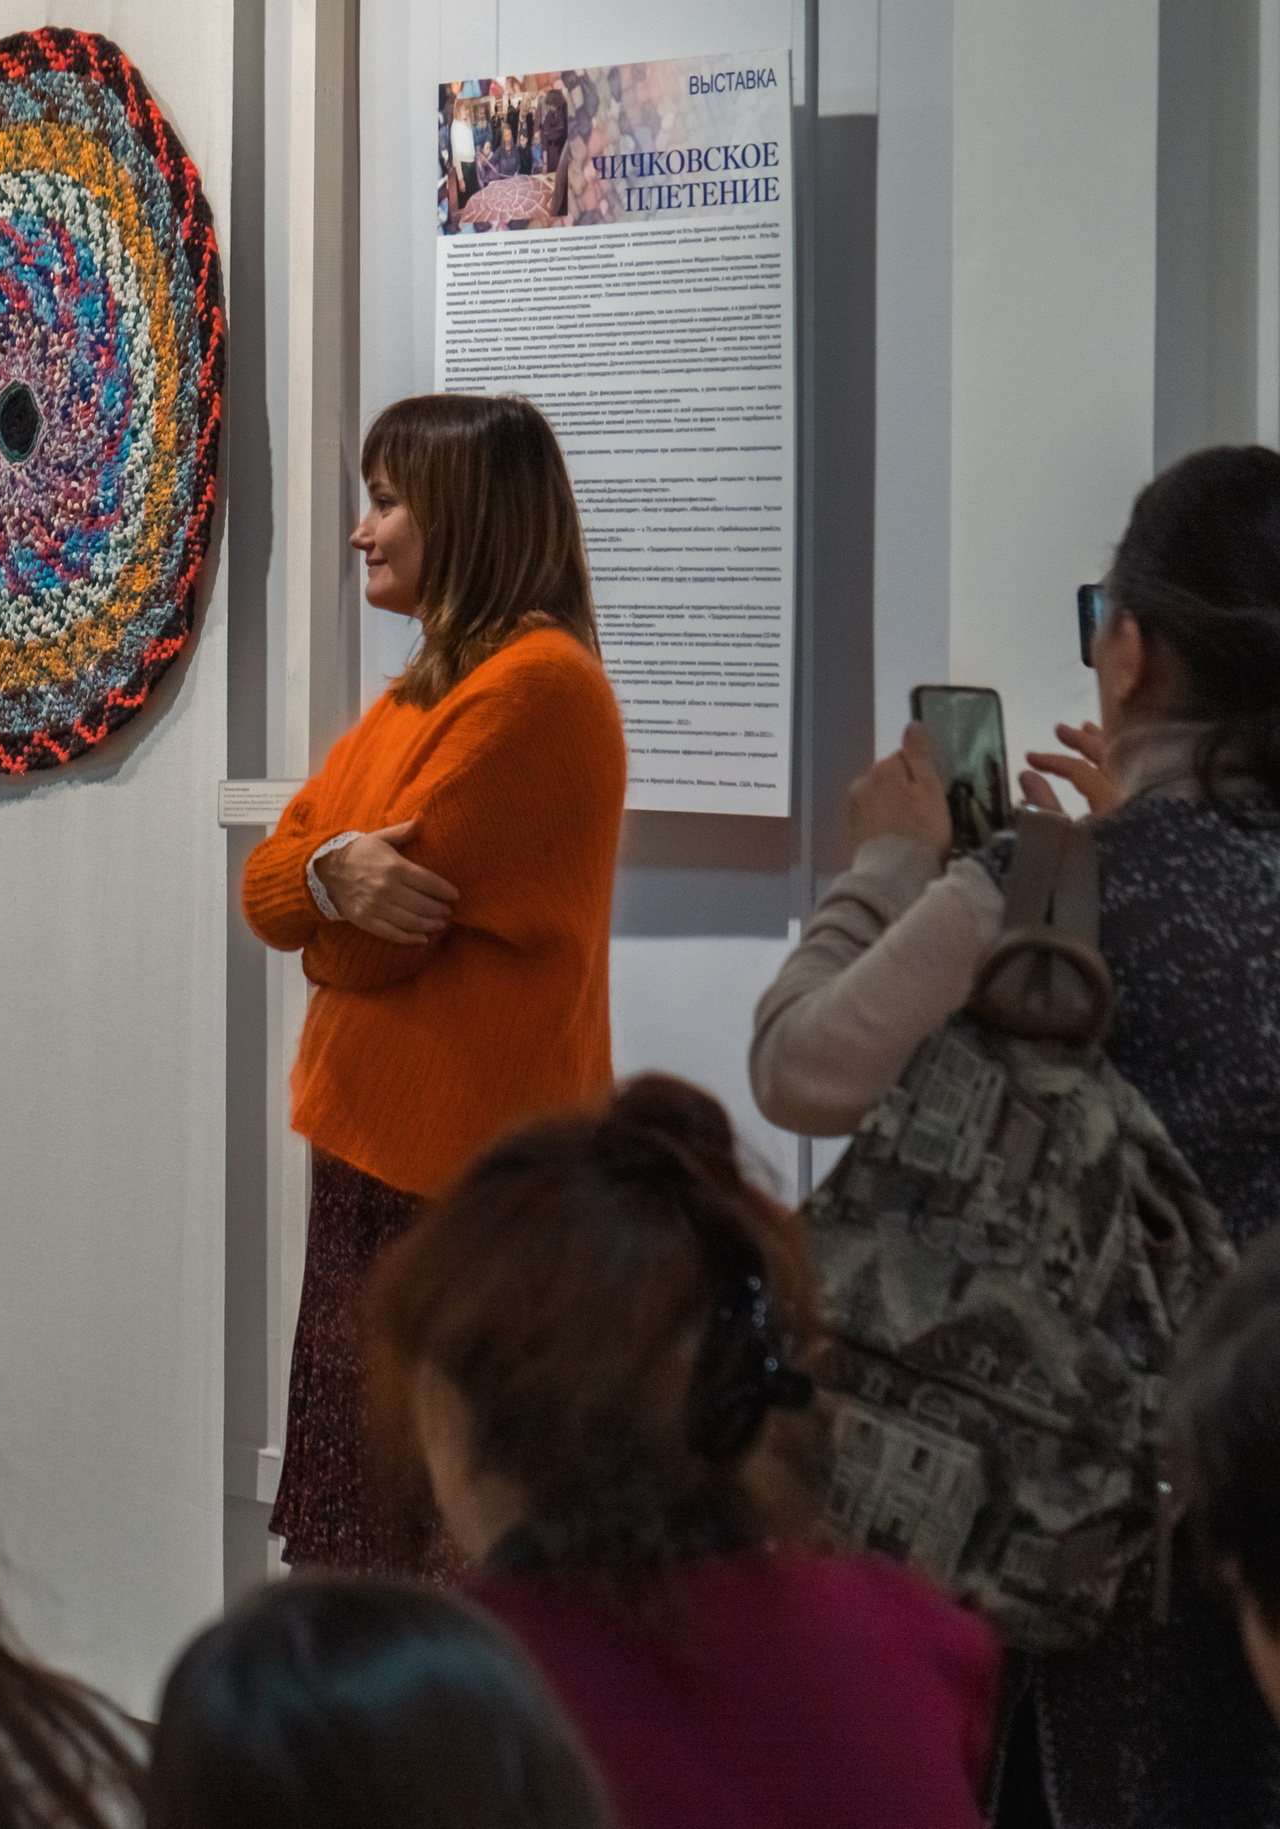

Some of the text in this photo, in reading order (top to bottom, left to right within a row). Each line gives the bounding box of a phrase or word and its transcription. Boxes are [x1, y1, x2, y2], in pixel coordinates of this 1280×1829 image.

[689, 68, 777, 95] ВЫСТАВКА
[592, 142, 780, 180] ЧИЧКОВСКОЕ
[625, 177, 780, 212] ПЛЕТЕНИЕ
